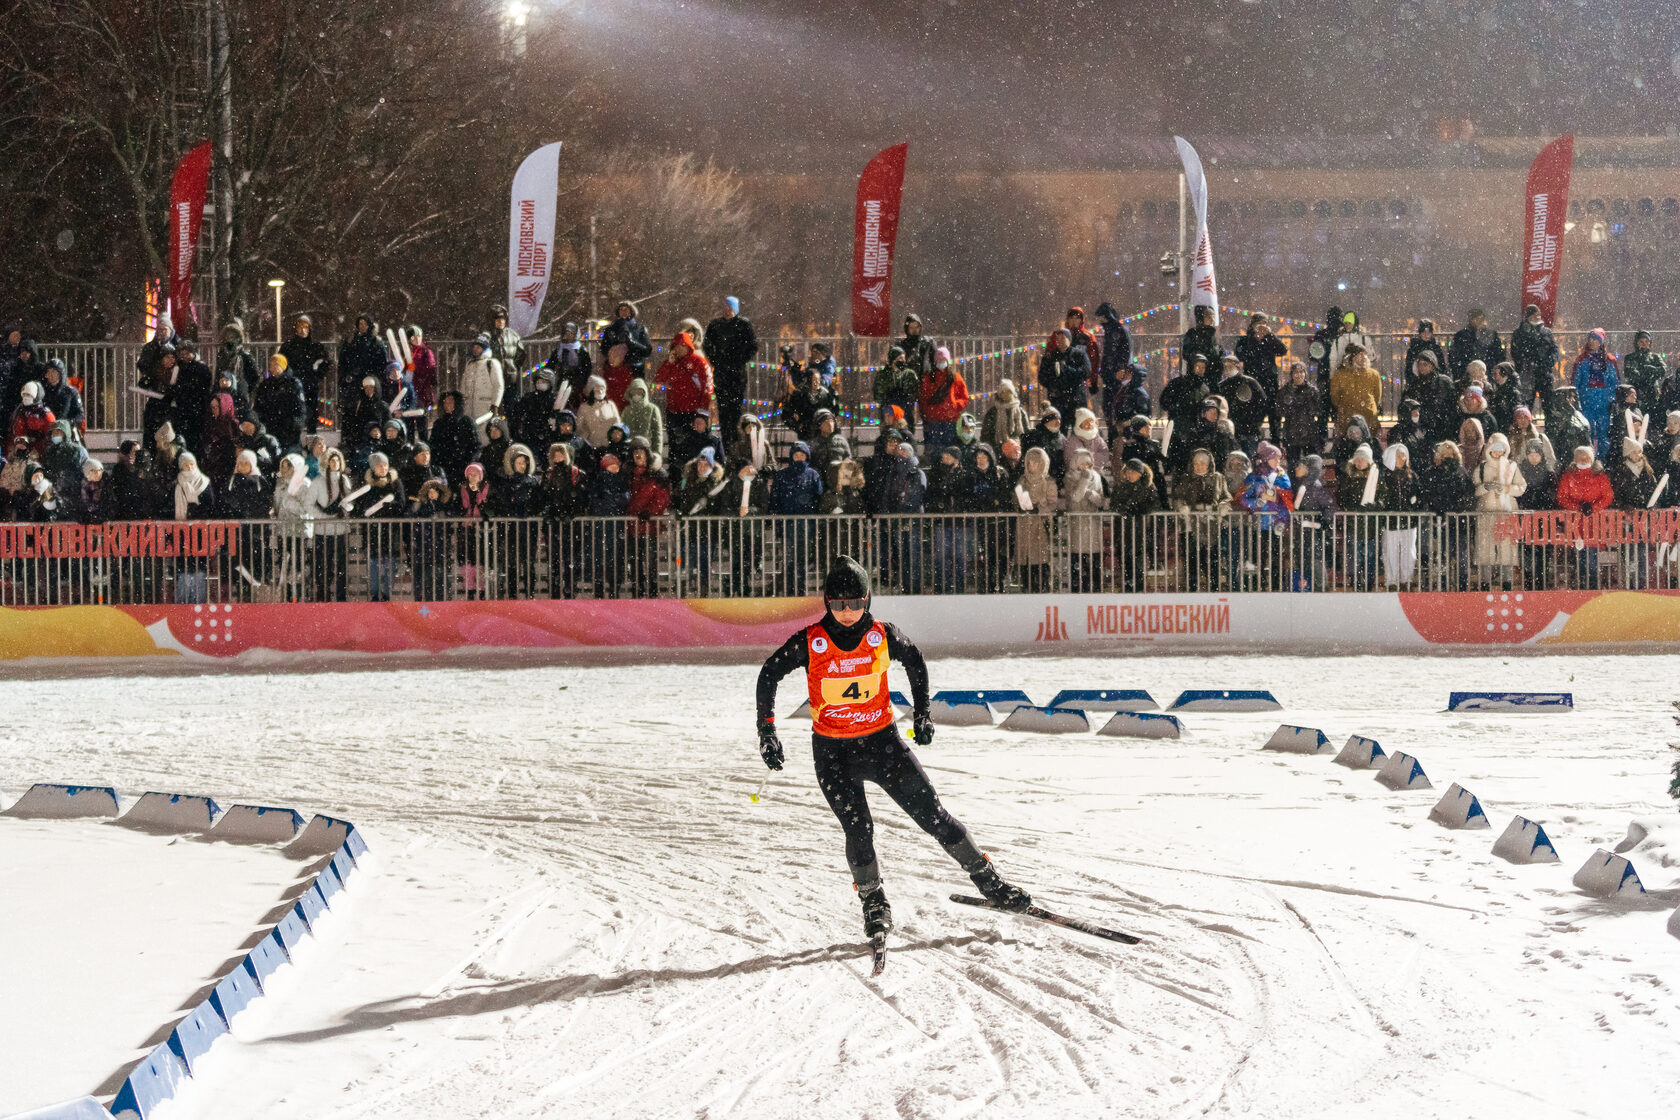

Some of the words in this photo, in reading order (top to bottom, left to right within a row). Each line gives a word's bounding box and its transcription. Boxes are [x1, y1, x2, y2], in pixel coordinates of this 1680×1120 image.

[517, 200, 535, 277] МОСКОВСКИЙ
[863, 200, 881, 277] МОСКОВСКИЙ
[1528, 193, 1549, 270] МОСКОВСКИЙ
[532, 241, 547, 277] СПОРТ
[877, 241, 889, 277] СПОРТ
[1543, 234, 1557, 270] СПОРТ
[1087, 598, 1230, 634] МОСКОВСКИЙ
[842, 682, 861, 699] 4
[863, 690, 870, 699] 1
